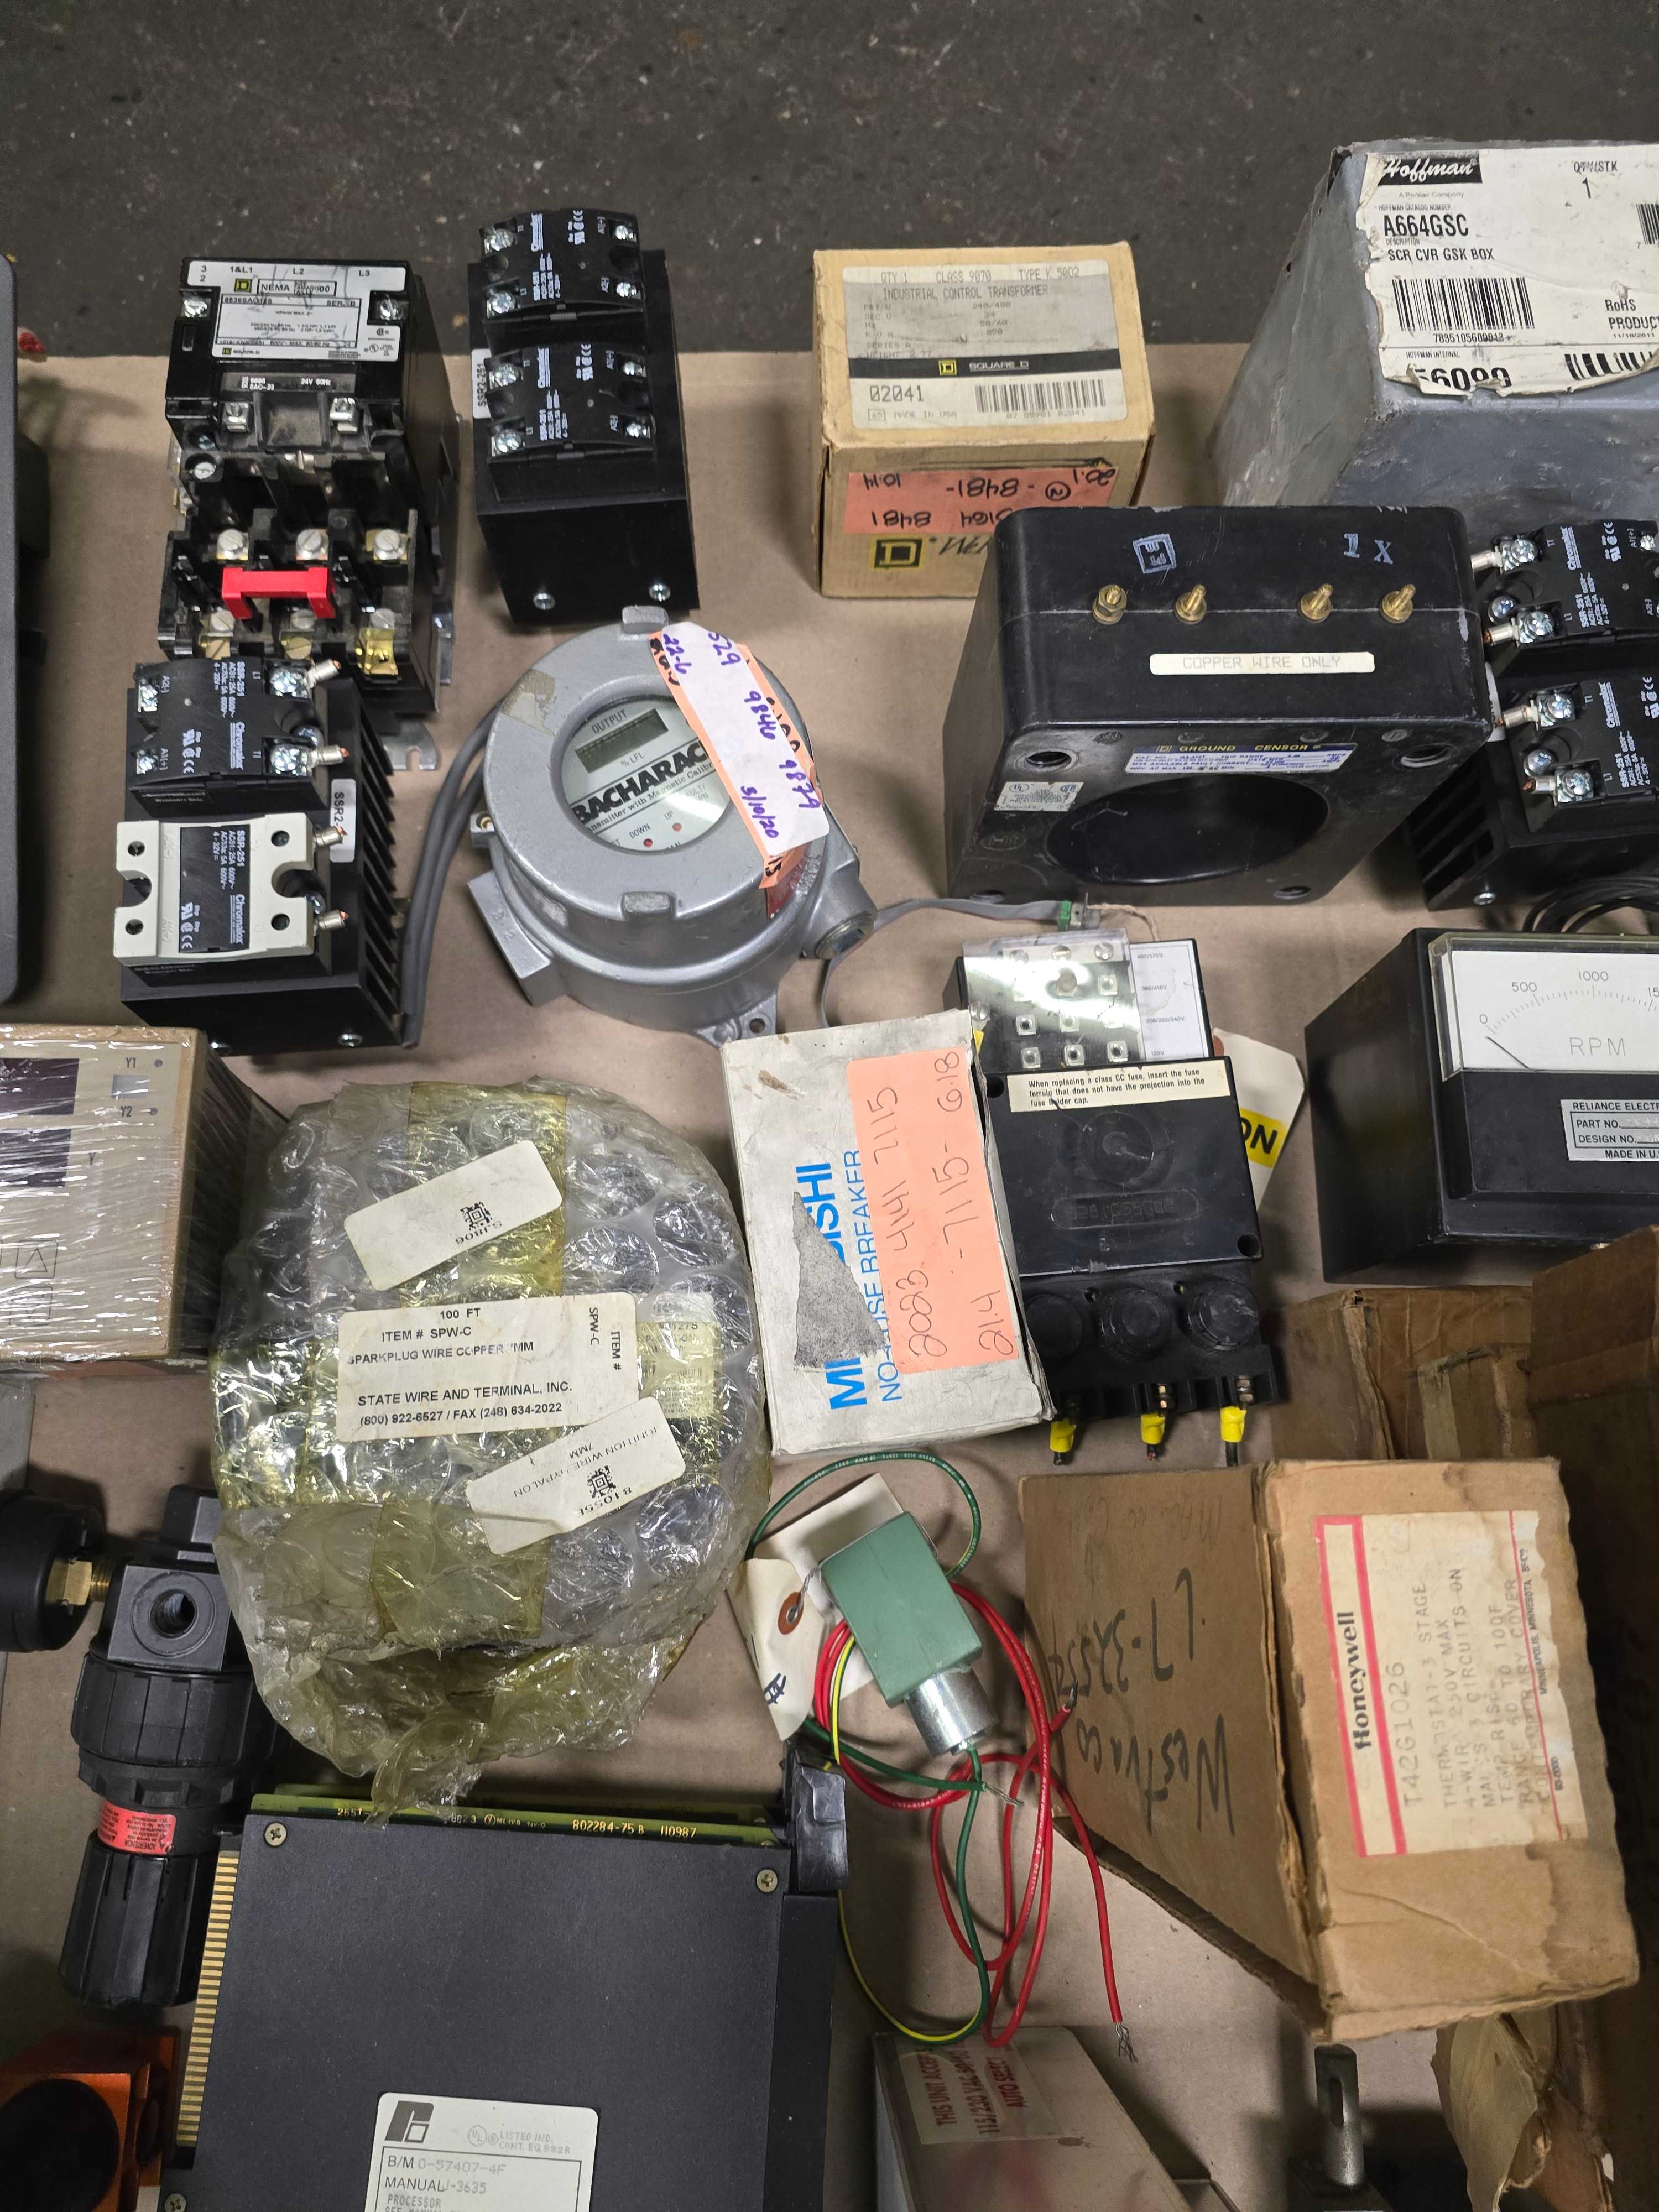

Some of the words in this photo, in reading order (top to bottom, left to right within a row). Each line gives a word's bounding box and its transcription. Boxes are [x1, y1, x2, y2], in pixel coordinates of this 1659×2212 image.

[1384, 158, 1473, 182] Hoffman
[1582, 178, 1591, 199] 1
[1384, 214, 1469, 237] A664GSC
[1386, 238, 1420, 246] DESCRIPTION
[1388, 249, 1411, 261] SCR
[1416, 249, 1439, 261] CVR
[1443, 248, 1468, 261] GSK
[1471, 248, 1495, 260] BOX
[881, 271, 898, 283] QTY
[904, 271, 908, 283] 1
[936, 270, 964, 283] CLASS
[1018, 268, 1042, 281] TYPE
[883, 288, 938, 301] INDUSTRIAL
[943, 286, 982, 300] CONTROL
[987, 284, 1048, 298] TRANSFORMER
[1605, 299, 1636, 311] RoHS
[969, 361, 1012, 369] SQUARE
[869, 385, 924, 403] 02041
[1183, 656, 1243, 670] COPPER
[1253, 655, 1292, 669] WIRE
[1302, 655, 1340, 669] ONLY
[236, 661, 246, 696] SSR-251
[591, 709, 628, 734] OUTPUT
[235, 722, 244, 770] Chromalox
[629, 751, 645, 764] LFL
[628, 796, 647, 812] with
[664, 810, 674, 820] UP
[629, 823, 650, 839] DOWN
[237, 830, 246, 867] SSR-251
[236, 894, 246, 945] Chromalox
[1479, 1013, 1488, 1025] 0
[1511, 981, 1537, 993] 500
[1578, 971, 1609, 982] 1000
[1569, 1037, 1626, 1057] RPM
[126, 1057, 136, 1069] Y1
[1052, 1078, 1084, 1087] replacing
[1140, 1080, 1175, 1090] projection
[120, 1105, 133, 1118] Y2
[1572, 1102, 1621, 1111] RELIANCE
[1577, 1119, 1600, 1128] PART
[1604, 1119, 1621, 1128] NO.
[1579, 1135, 1616, 1144] DESIGN
[1620, 1135, 1636, 1144] NO.
[1605, 1150, 1633, 1159] MADE
[1636, 1150, 1646, 1159] IN
[440, 1310, 460, 1319] 100
[467, 1308, 481, 1317] FT
[589, 1307, 599, 1345] SPW-C
[382, 1330, 412, 1342] ITEM
[415, 1329, 424, 1339] #
[430, 1327, 472, 1339] SPW-C
[611, 1331, 620, 1359] ITEM
[422, 1348, 452, 1359] WIRE
[358, 1394, 400, 1406] STATE
[405, 1390, 439, 1403] WIRE
[442, 1388, 469, 1400] AND
[547, 1381, 572, 1392] INC.
[360, 1414, 388, 1427] (800)
[392, 1411, 443, 1423] 922-6527
[453, 1408, 476, 1420] FAX
[479, 1406, 508, 1419] (248)
[510, 1402, 562, 1415] 634-2022
[568, 1443, 594, 1459] 7MM
[576, 1451, 603, 1470] WIRE
[1448, 1568, 1463, 1592] ON
[1412, 1582, 1432, 1642] STAGE
[1504, 1579, 1523, 1639] COVER
[1524, 1579, 1537, 1630] MINNESOTA
[1436, 1619, 1453, 1655] MAX
[1453, 1605, 1481, 1703] CIRCUITS
[1337, 1610, 1372, 1750] Honeywell
[1499, 1665, 1514, 1690] TO
[1386, 1661, 1424, 1808] T42G1026
[998, 2084, 1029, 2108] AUTO
[499, 2131, 531, 2141] LISTED
[534, 2133, 551, 2142] IND.
[499, 2141, 525, 2151] CONT.
[528, 2142, 542, 2152] EQ
[388, 2155, 415, 2168] B/M
[385, 2176, 445, 2192] MANUAL
[387, 2193, 441, 2208] PROCESSOR
